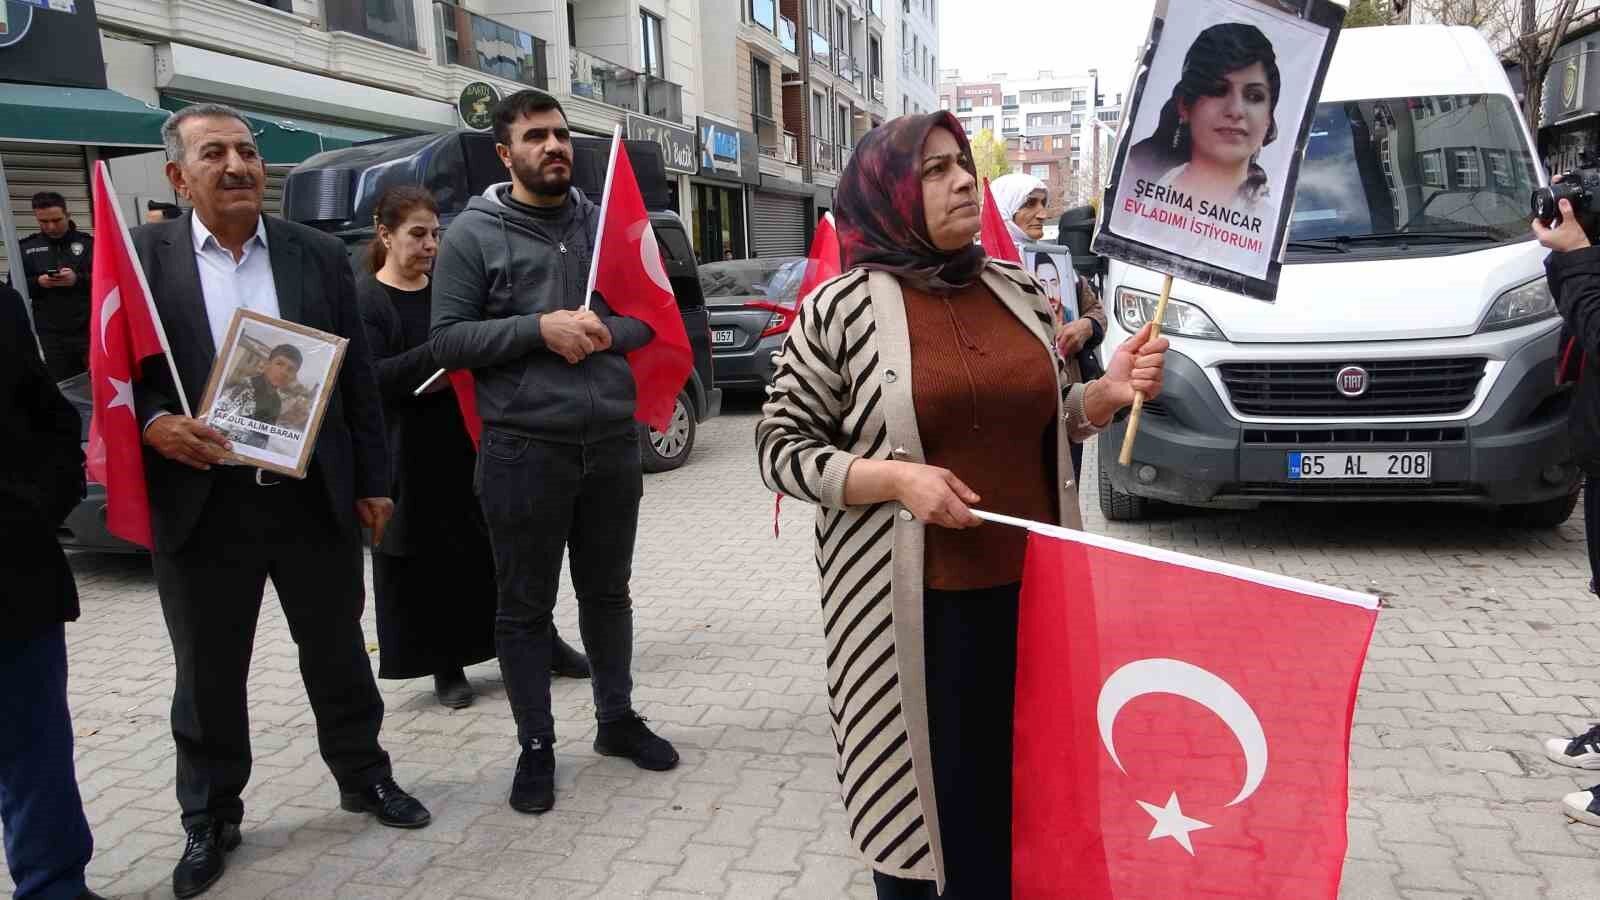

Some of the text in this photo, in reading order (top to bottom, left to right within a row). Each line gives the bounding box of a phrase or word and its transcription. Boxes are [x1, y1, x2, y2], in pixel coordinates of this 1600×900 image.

[1134, 178, 1263, 233] ŞERİMA SANCAR
[1123, 198, 1263, 254] EVLADIMI İSTİYORUM!
[1344, 375, 1362, 389] FIAT
[270, 425, 300, 441] BARAN
[1301, 455, 1325, 475] 65
[1344, 455, 1368, 475] AL
[1387, 454, 1426, 475] 208
